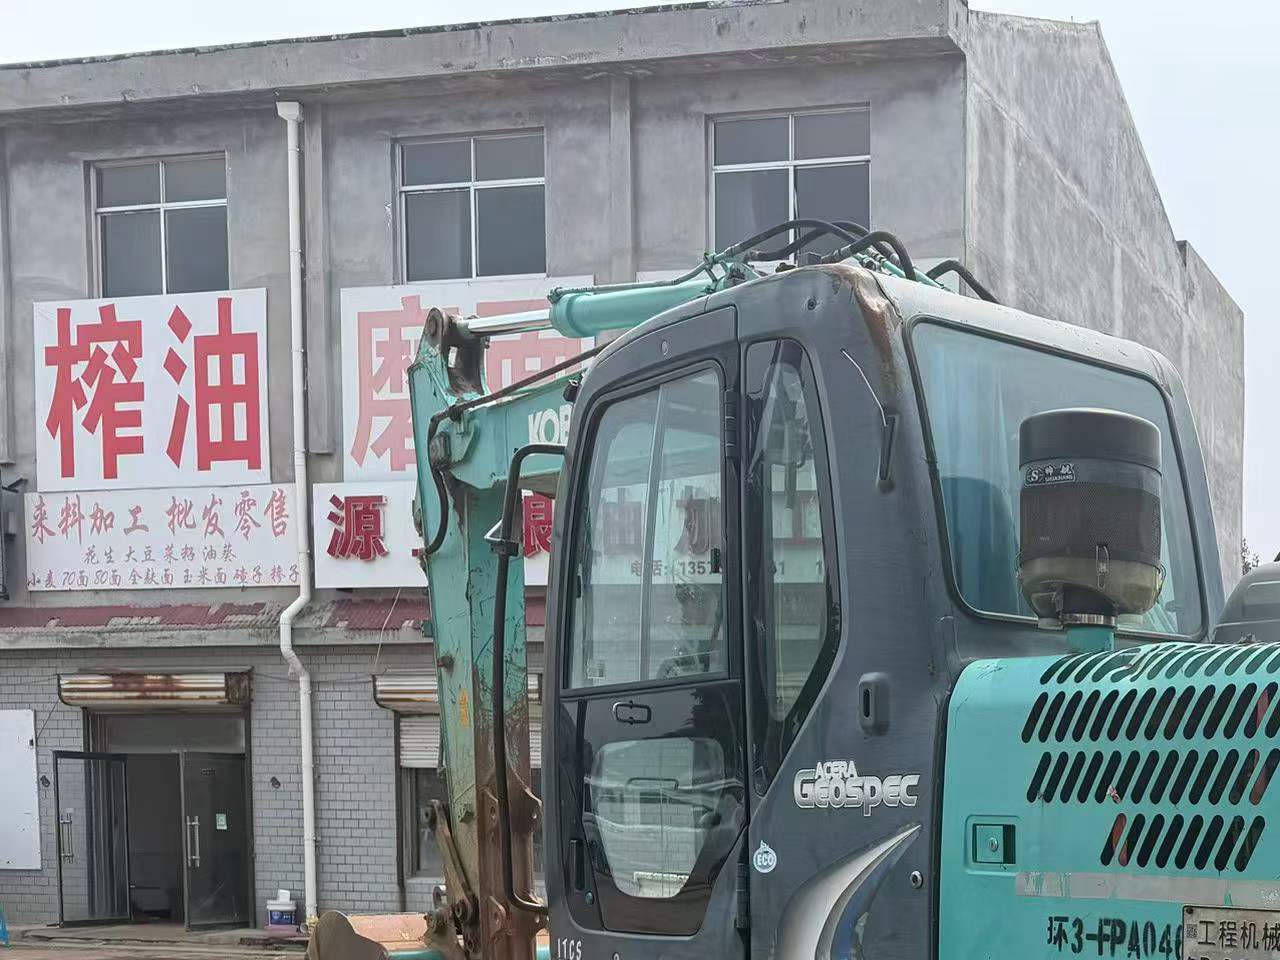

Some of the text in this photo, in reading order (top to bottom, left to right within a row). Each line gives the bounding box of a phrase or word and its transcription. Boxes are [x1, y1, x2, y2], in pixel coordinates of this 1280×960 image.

[44, 297, 262, 479] 榨油
[31, 488, 290, 545] 来料加工 批发零售
